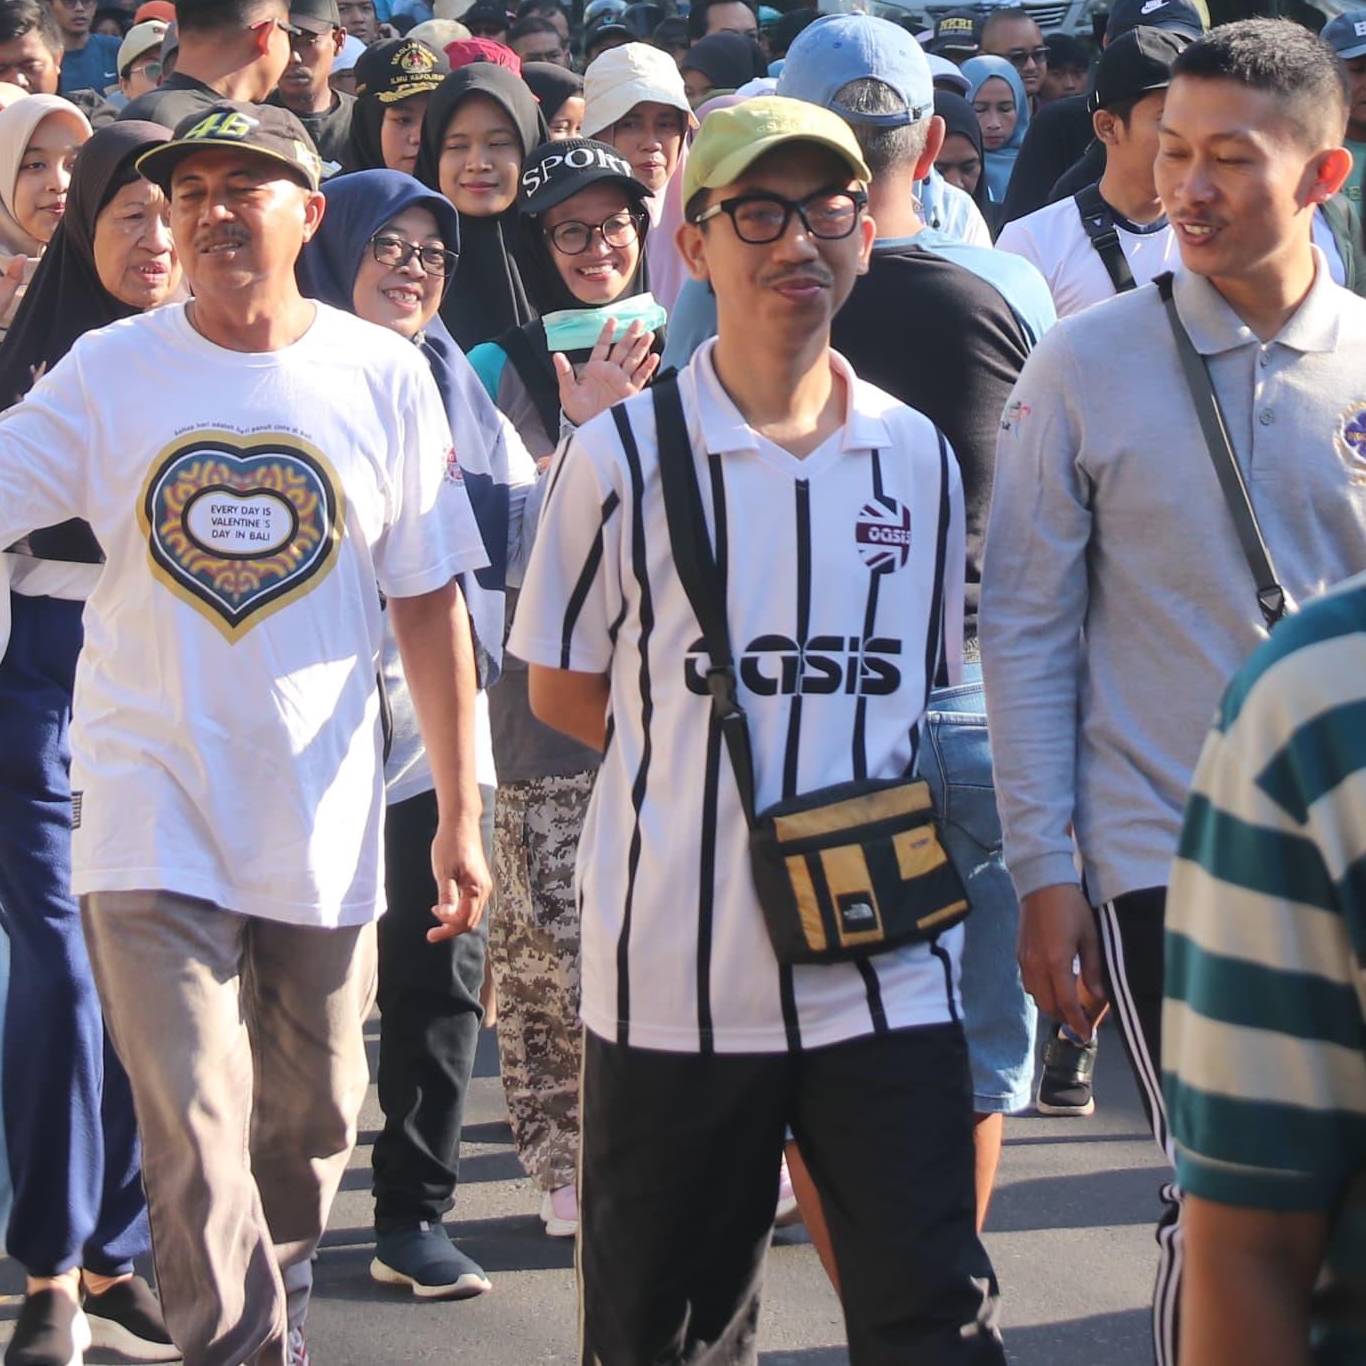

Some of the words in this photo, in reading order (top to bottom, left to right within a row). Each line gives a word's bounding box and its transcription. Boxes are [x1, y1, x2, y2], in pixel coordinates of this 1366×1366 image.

[185, 112, 259, 139] 46
[522, 148, 632, 198] SPORT
[210, 504, 238, 514] EVERY
[241, 506, 260, 516] DAY
[262, 507, 272, 517] IS
[210, 517, 260, 528] VALENTINE
[211, 529, 230, 539] DAY
[235, 530, 245, 539] IN
[249, 531, 271, 542] BALI
